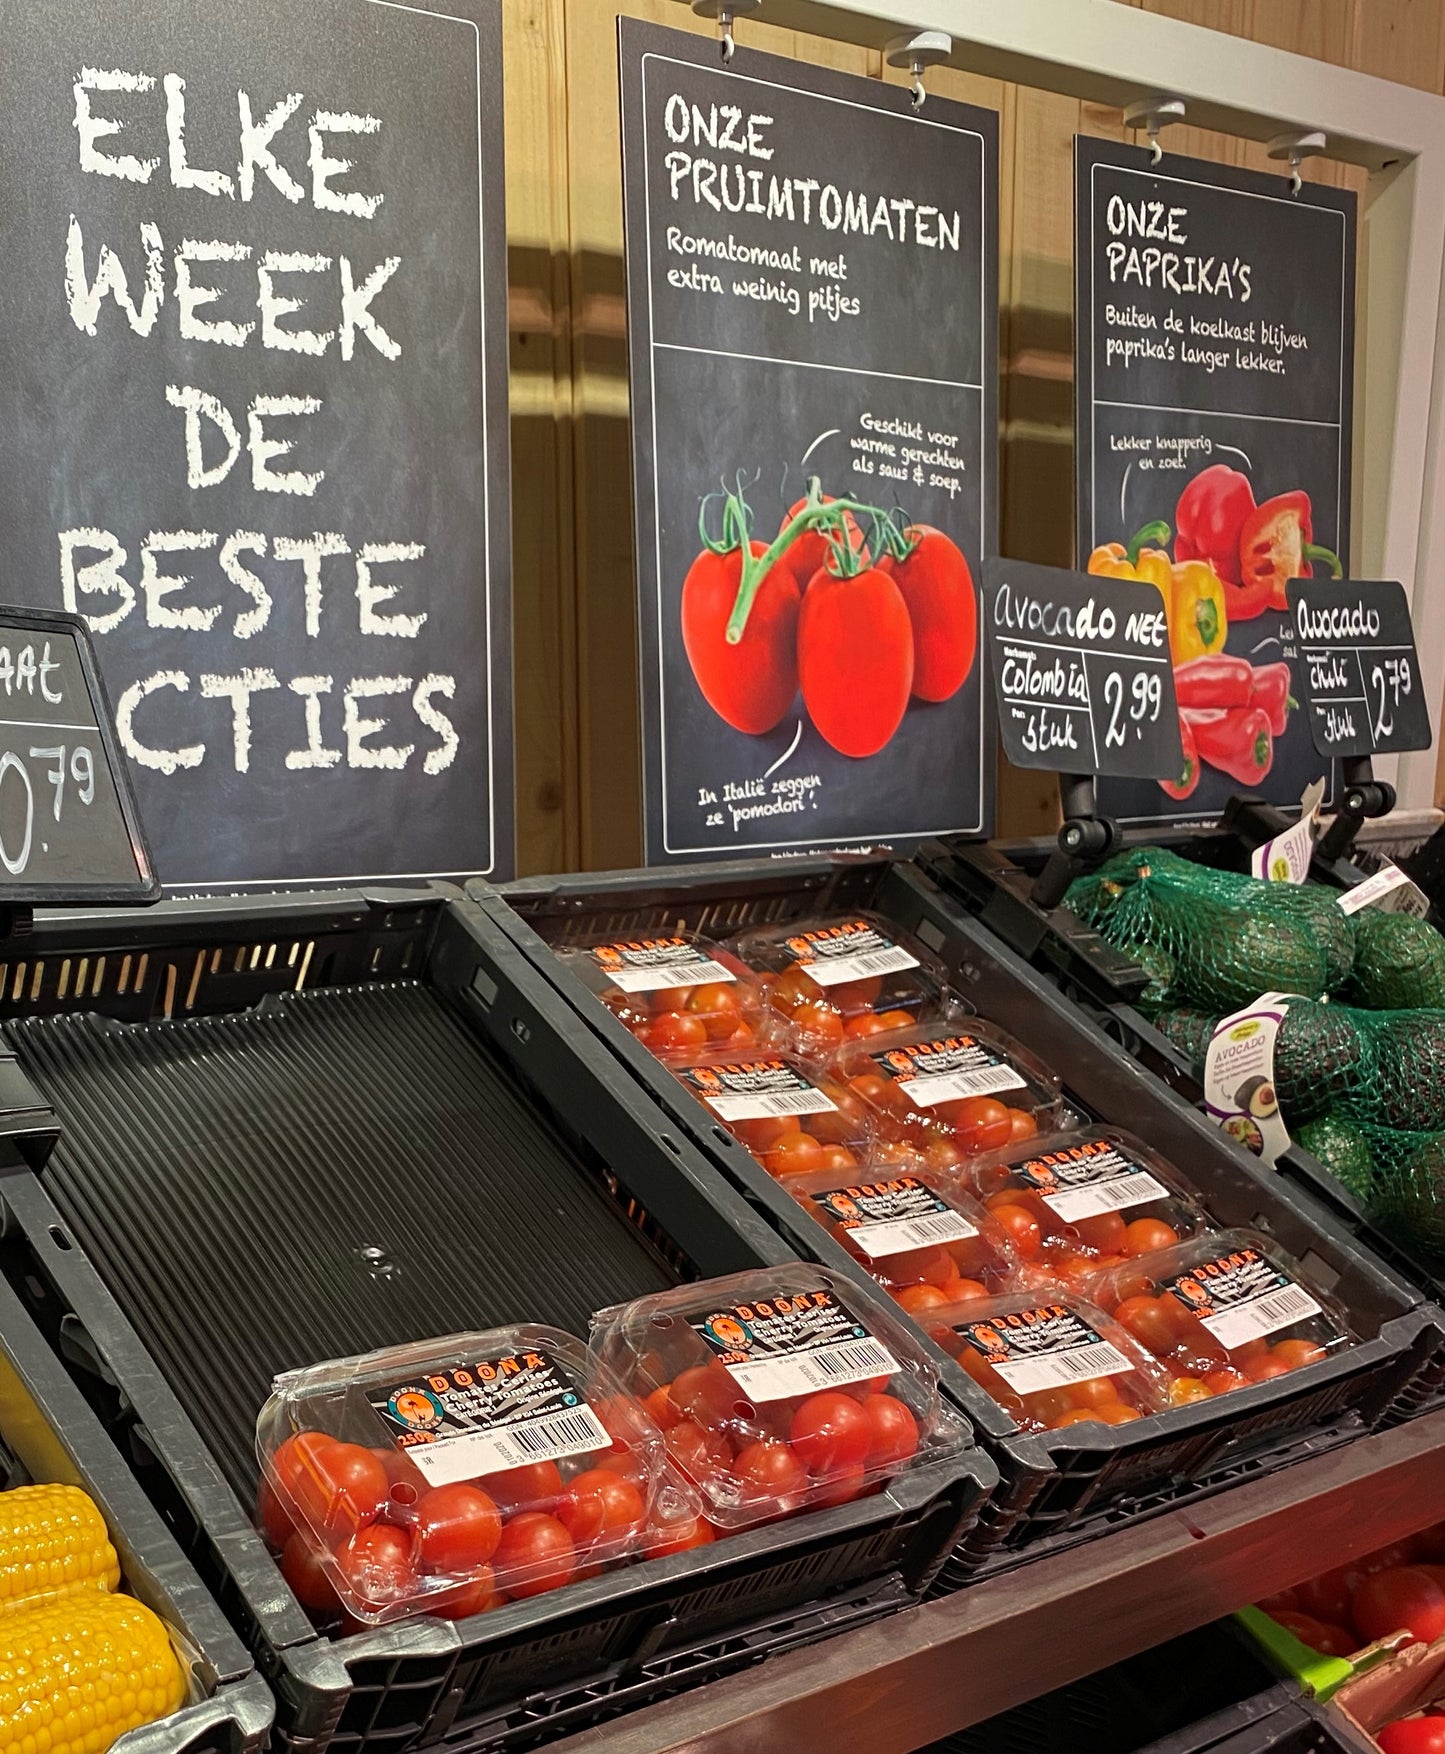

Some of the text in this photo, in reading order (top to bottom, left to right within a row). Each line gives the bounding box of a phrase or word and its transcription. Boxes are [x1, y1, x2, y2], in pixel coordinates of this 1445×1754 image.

[73, 65, 384, 219] ELKE
[664, 93, 774, 160] ONZE
[664, 151, 960, 251] PRUIMTOMATEN
[1106, 195, 1188, 245] ONZE
[667, 226, 847, 280] Romatomaat met
[1106, 242, 1251, 302] PAPRIKA'S
[65, 213, 401, 361] WEEK
[667, 264, 860, 323] extra weinig pitjes
[1105, 304, 1308, 354] Buiten de koelkast blijven
[1106, 337, 1286, 375] paprika's langer lekker.
[166, 385, 325, 496] DE
[860, 412, 959, 448] Geschikt voor
[1110, 434, 1212, 458] Lekker knapperig
[850, 437, 966, 471] warme gerechten
[1139, 458, 1154, 470] en
[852, 455, 962, 500] als saus & soep.
[58, 527, 427, 638] BESTE
[1001, 658, 1089, 702] Colombia
[698, 774, 822, 806] In Italië zeggen
[705, 812, 725, 826] ze
[1215, 1035, 1266, 1063] AVOCADO
[735, 1293, 833, 1321] DOONA
[428, 1353, 546, 1393] DOONA
[440, 1370, 550, 1402] Tomates Cerises
[390, 1386, 425, 1402] DOONA
[445, 1377, 559, 1412] Cherry Tomatoes
[397, 1431, 436, 1446] 250g
